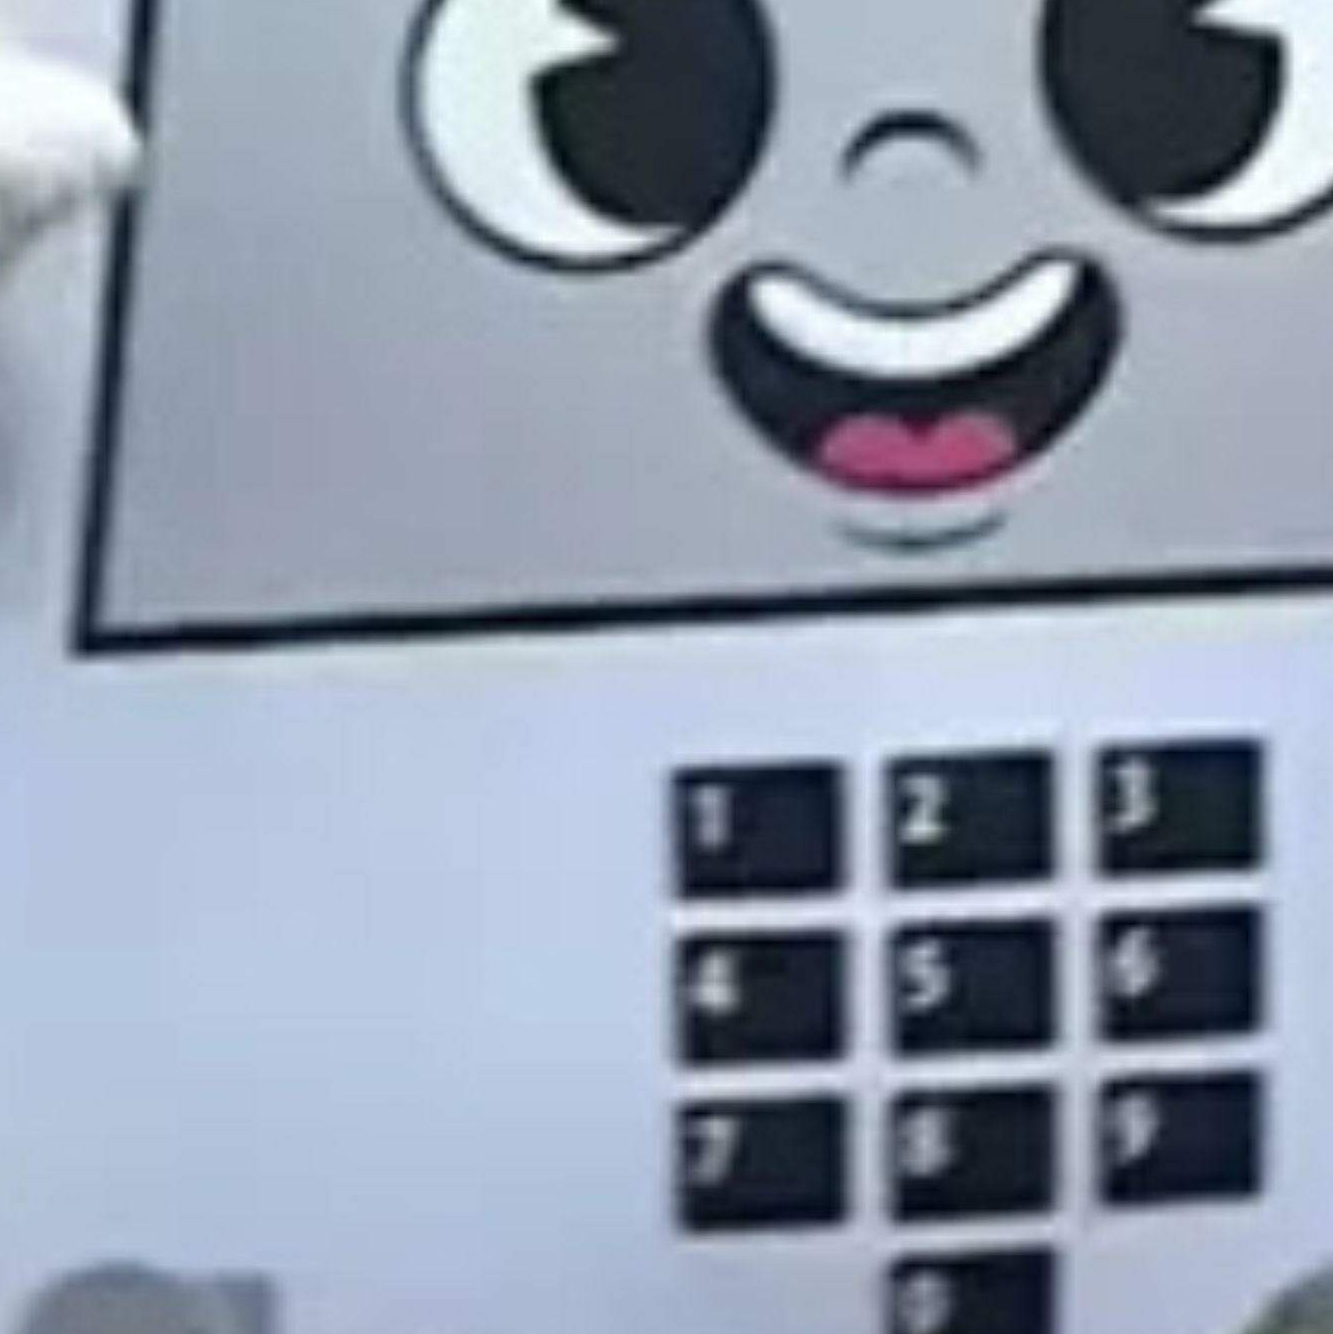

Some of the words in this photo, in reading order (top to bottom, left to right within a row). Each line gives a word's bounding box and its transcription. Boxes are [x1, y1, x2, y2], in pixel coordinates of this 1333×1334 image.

[688, 782, 732, 852] 1
[895, 771, 949, 845] 2
[1108, 756, 1156, 835] 3
[685, 947, 739, 1017] 4
[895, 937, 951, 1013] 5
[1111, 925, 1159, 997] 6
[685, 1113, 740, 1184] 7
[895, 1105, 953, 1178] 8
[1108, 1091, 1159, 1169] 9
